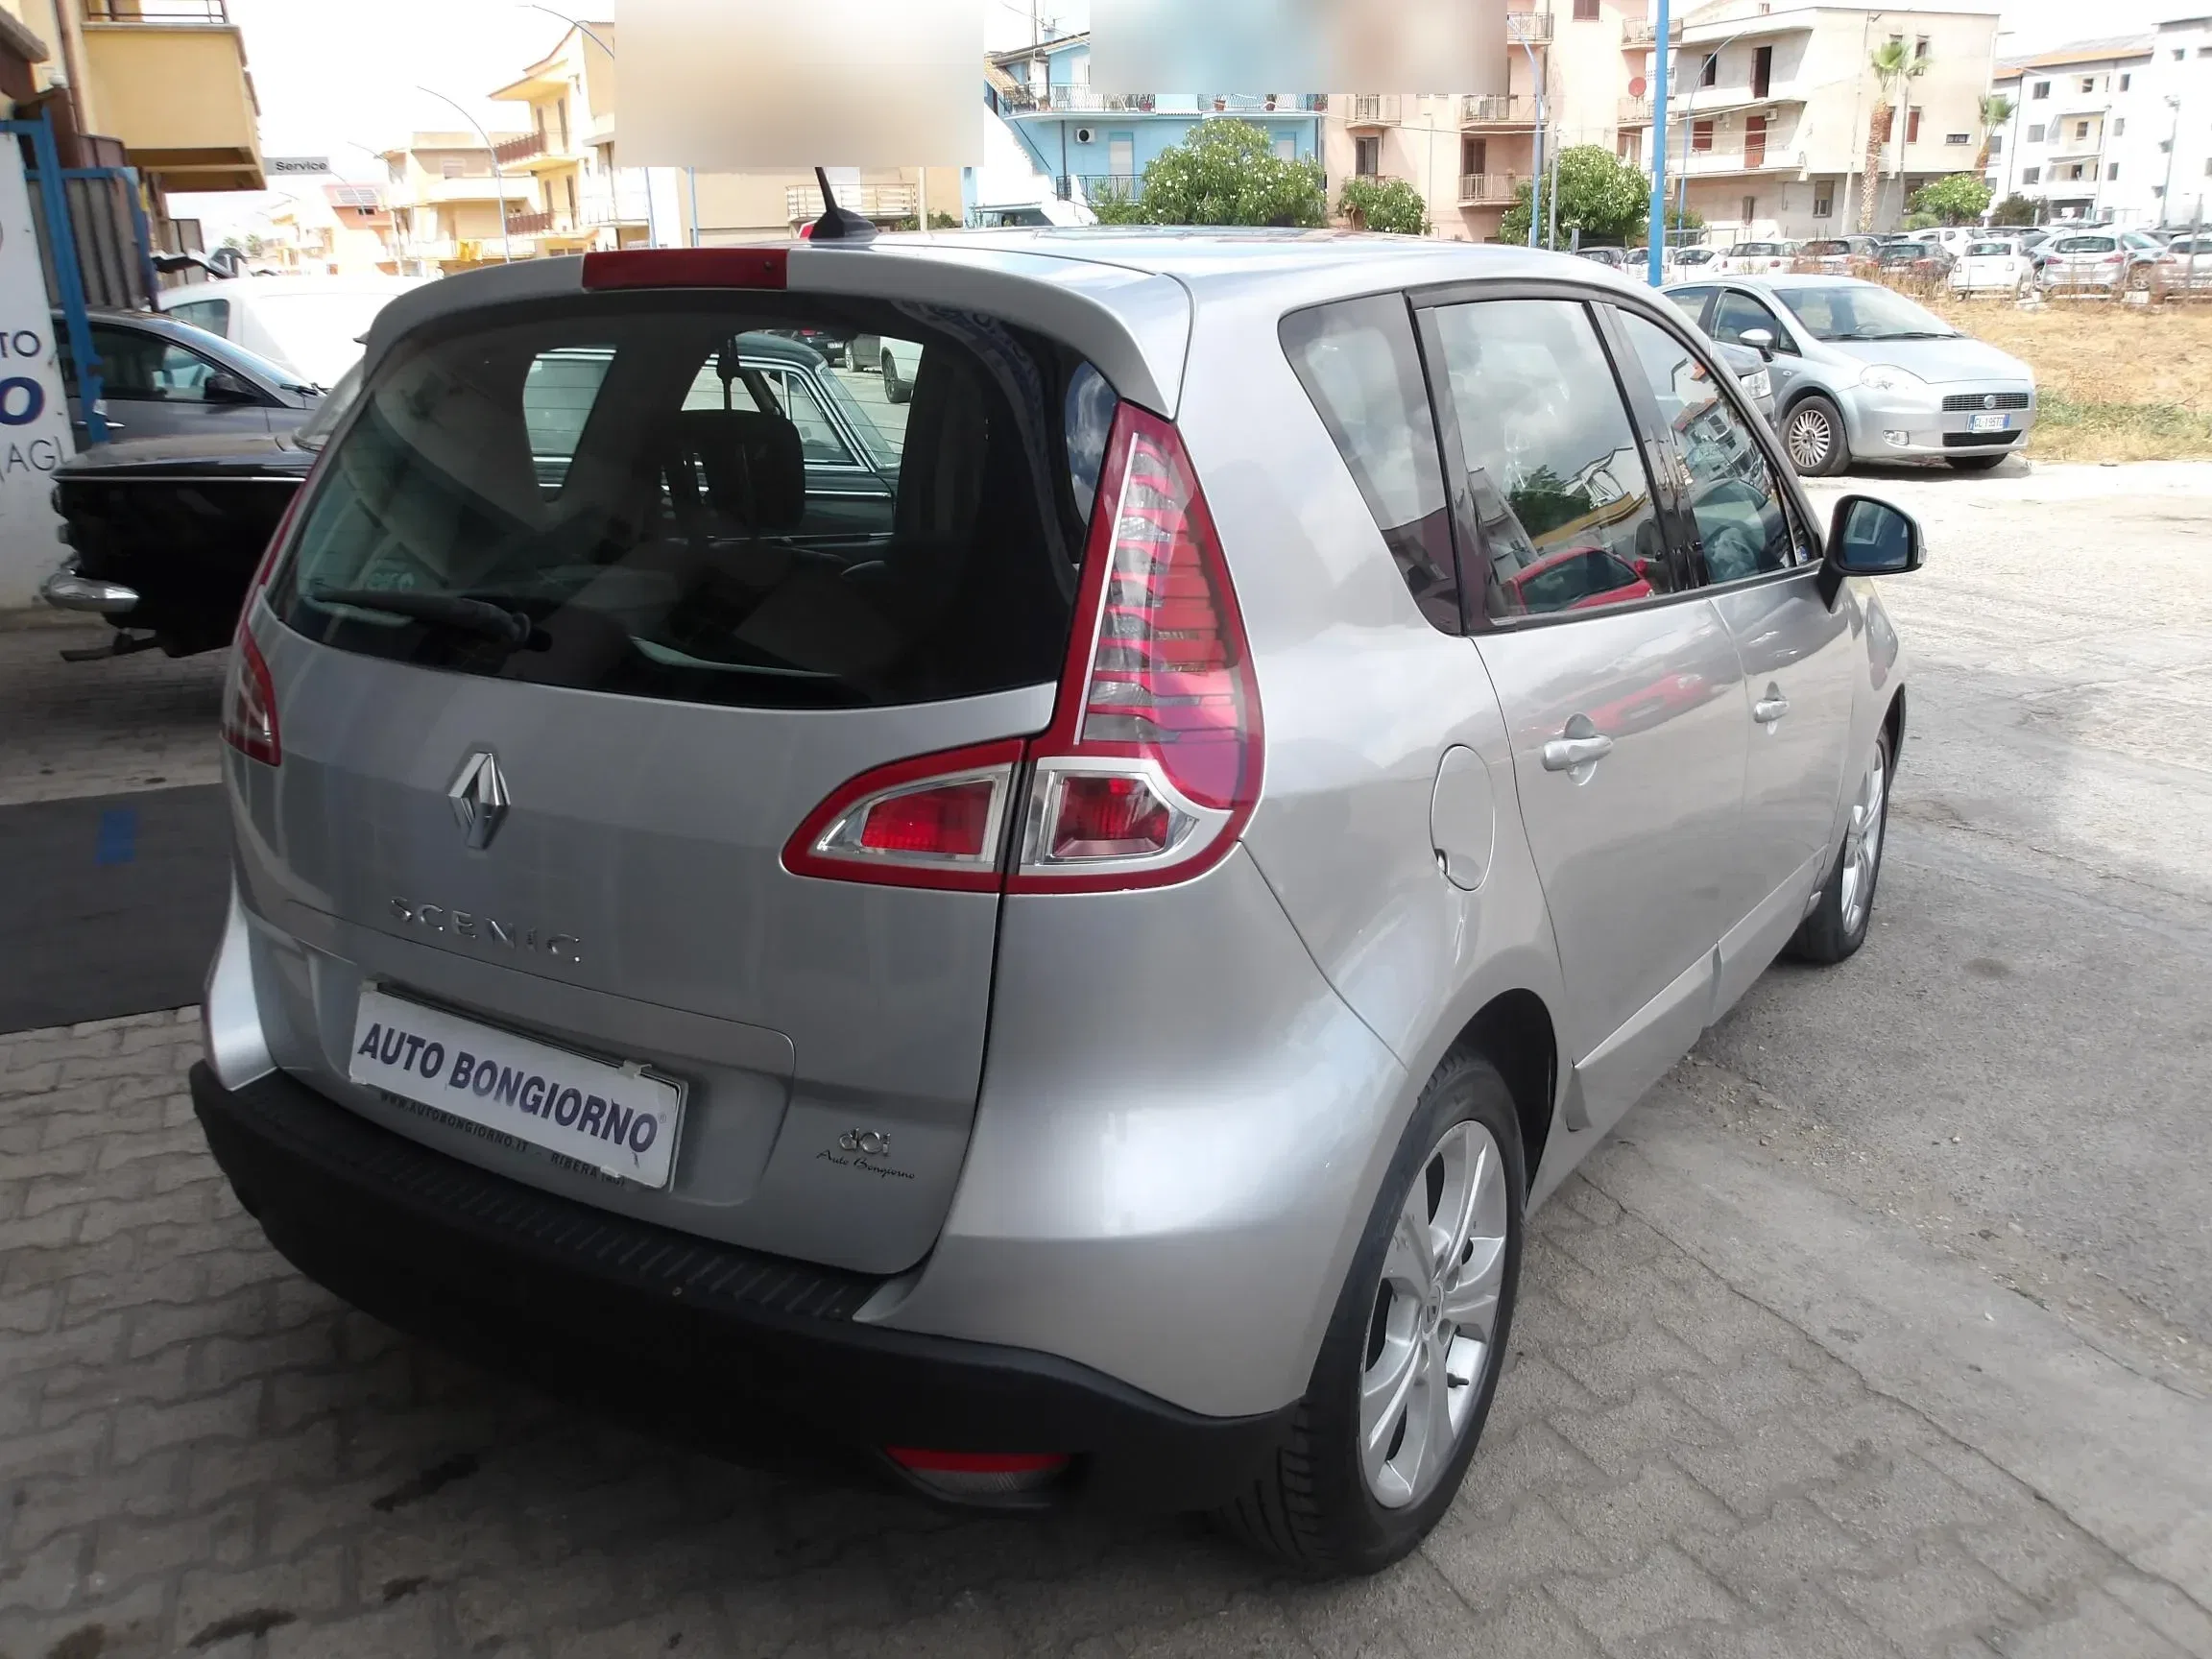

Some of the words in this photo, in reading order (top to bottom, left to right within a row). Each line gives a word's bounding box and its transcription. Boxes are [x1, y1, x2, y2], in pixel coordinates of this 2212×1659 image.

[276, 161, 327, 171] Service
[390, 896, 582, 964] SCENIC
[357, 1023, 445, 1078] AUTO
[448, 1051, 658, 1153] BONGIORNO
[550, 1152, 597, 1178] RIBERA
[816, 1149, 849, 1166] Auto
